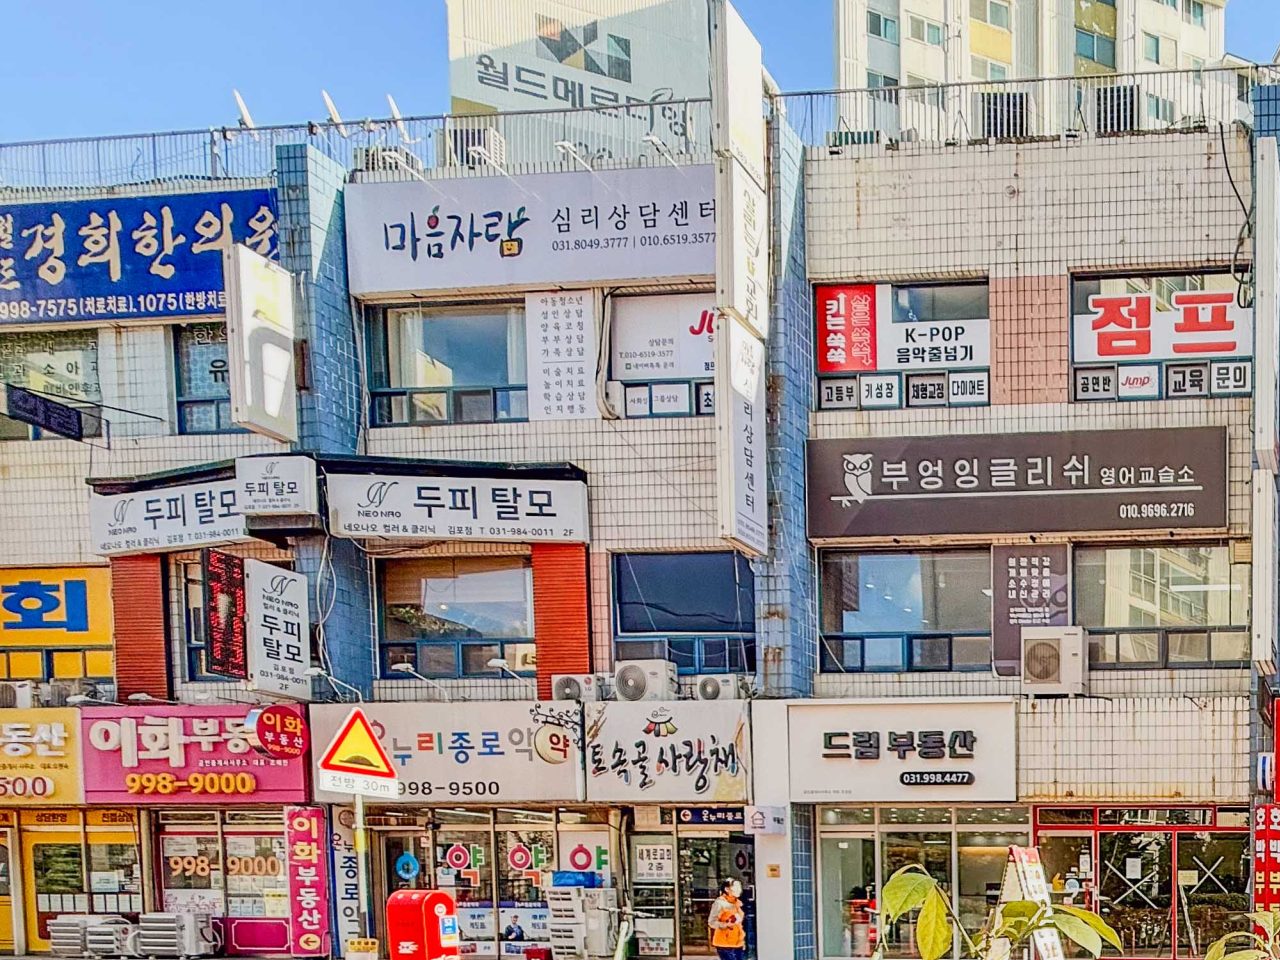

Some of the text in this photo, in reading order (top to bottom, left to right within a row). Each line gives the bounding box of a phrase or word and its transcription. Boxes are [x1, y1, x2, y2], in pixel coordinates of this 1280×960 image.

[552, 199, 716, 233] 심리상담센터
[385, 207, 530, 262] 마음자람
[552, 237, 629, 251] 031.8049.3777
[905, 326, 966, 342] K-POP
[1091, 292, 1237, 357] 점프
[897, 345, 974, 363] 음악줄넘기
[865, 379, 893, 399] 키성장
[952, 380, 985, 396] 다이어트
[1081, 376, 1111, 392] 공연반
[1172, 369, 1204, 393] 교육
[1216, 365, 1247, 389] 문의
[881, 453, 1195, 490] 부엉잉글리쉬 영어교습소
[244, 481, 299, 497] 두피 탈모
[144, 489, 240, 531] 두피 탈모
[413, 486, 557, 521] 두피 탈모
[1119, 502, 1195, 518] 010.9696.2716
[343, 523, 378, 533] 네오나오
[489, 527, 554, 537] 031-984-0011
[563, 528, 574, 537] 2F
[1, 579, 89, 632] 회
[261, 613, 302, 643] 두피
[262, 636, 304, 664] 탈모
[262, 712, 304, 737] 이화
[264, 731, 304, 748] 부동산
[549, 731, 570, 759] 약
[821, 729, 977, 760] 드림 부동산
[656, 734, 740, 794] 사랑채
[125, 772, 256, 794] 998-9000
[330, 775, 390, 792] 전방 30m
[903, 772, 969, 785] 031.998.4477
[446, 842, 485, 887] 약
[508, 842, 547, 887] 약
